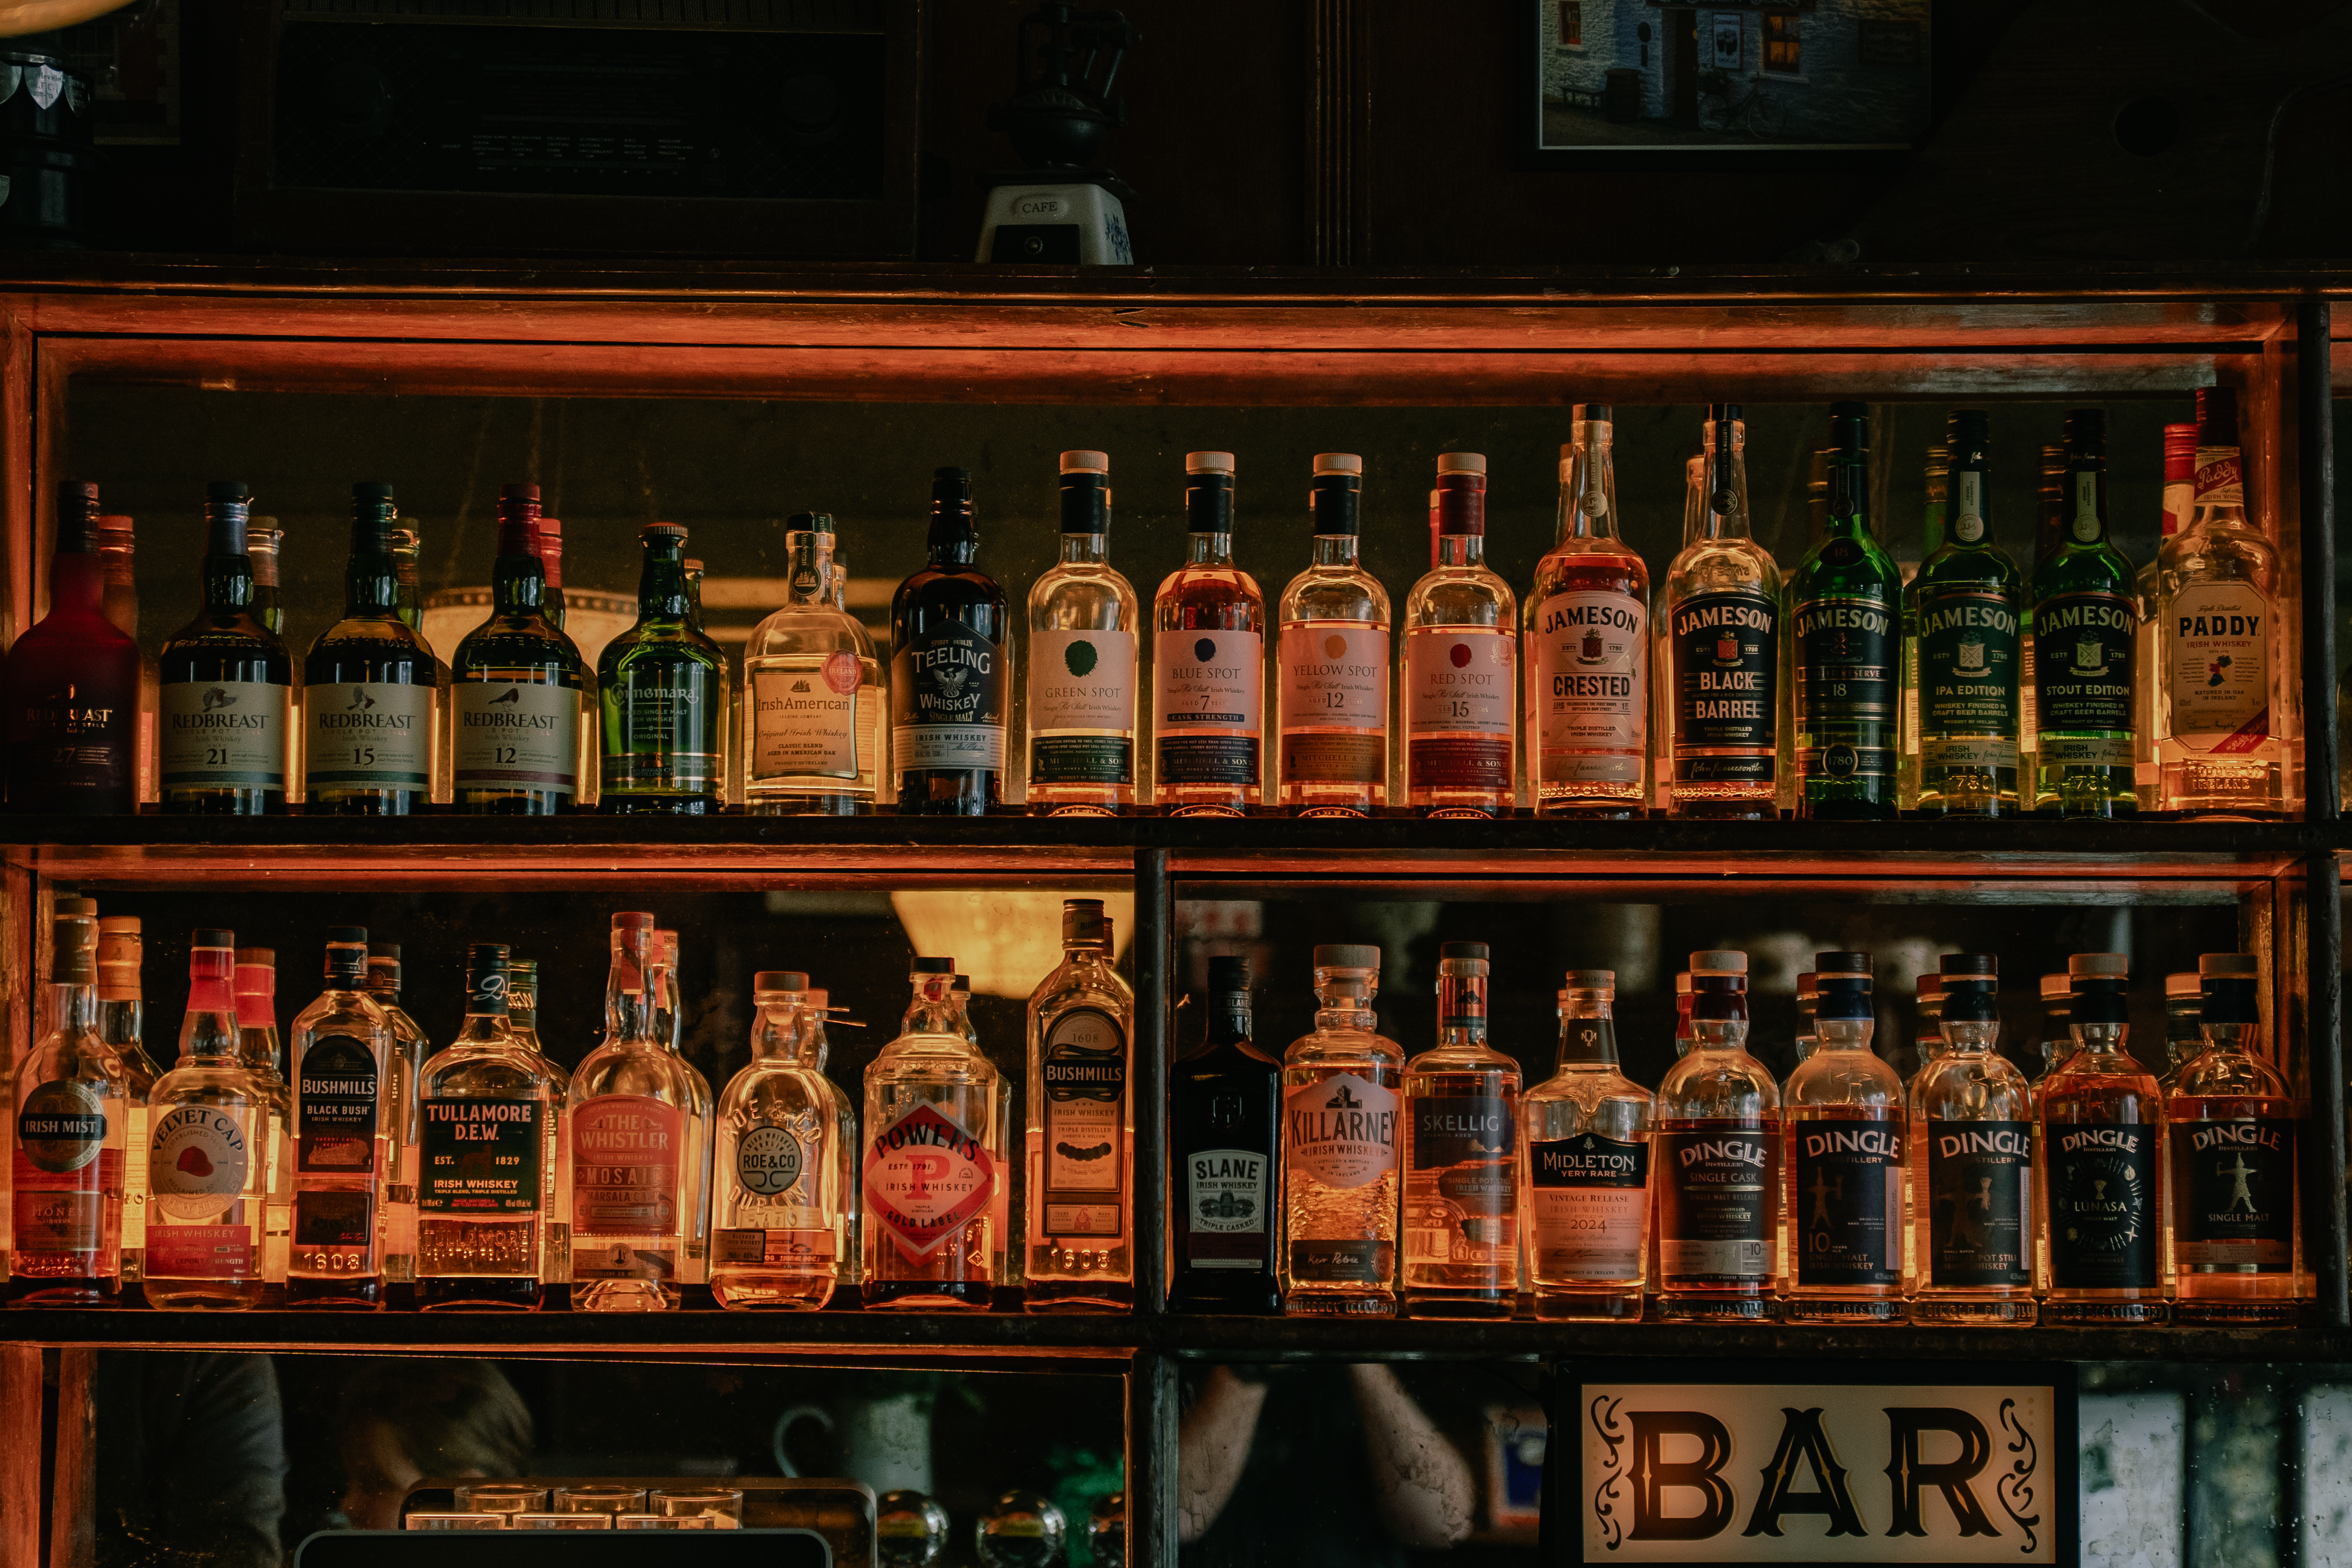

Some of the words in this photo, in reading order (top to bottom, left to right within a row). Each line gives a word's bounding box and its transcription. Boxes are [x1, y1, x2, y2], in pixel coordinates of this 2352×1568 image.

[2198, 461, 2239, 489] Paddy
[1546, 606, 1639, 635] JAMESON
[1679, 607, 1773, 636] JAMESON
[1798, 609, 1889, 638] JAMESON
[1922, 607, 2017, 637] JAMESON
[2040, 606, 2134, 637] JAMESON
[2179, 616, 2261, 637] PADDY
[911, 646, 990, 674] TEELING
[829, 668, 857, 676] IRELAND
[1173, 668, 1201, 679] BLUE
[1207, 668, 1240, 679] SPOT
[1293, 664, 1344, 678] YELLOW
[1348, 666, 1377, 678] SPOT
[1842, 669, 1880, 678] RESERVE
[1430, 674, 1455, 685] RED
[1460, 674, 1492, 685] SPOT
[1553, 676, 1630, 696] CRESTED
[1701, 672, 1755, 690] BLACK
[610, 683, 699, 706] Connemara
[1045, 687, 1087, 698] GREEN
[1091, 687, 1120, 698] SPOT
[1833, 684, 1847, 696] 18
[1936, 686, 1954, 696] IPA
[1958, 685, 2005, 696] EDITION
[2047, 686, 2081, 696] STOUT
[2086, 685, 2129, 697] EDITION
[758, 697, 849, 712] IrishAmerican
[920, 694, 980, 711] WHISKEY
[1200, 695, 1210, 711] 7
[1326, 692, 1344, 708] 12
[955, 712, 974, 722] MALT
[1452, 701, 1469, 717] 15
[1696, 701, 1760, 719] BARREL
[172, 714, 270, 730] REDBREAST
[319, 713, 415, 729] REDBREAST
[463, 711, 559, 730] REDBREAST
[52, 747, 76, 763] 27
[206, 748, 228, 765] 21
[353, 747, 375, 765] 15
[494, 747, 516, 764] 12
[1828, 756, 1853, 766] 1780
[2056, 752, 2098, 760] WHISKEY
[1072, 1033, 1099, 1044] 1608
[1046, 1065, 1123, 1082] BUSHMILLS
[303, 1080, 375, 1095] BUSHMILLS
[307, 1105, 338, 1115] BLACK
[342, 1106, 367, 1115] BUSH
[426, 1105, 531, 1123] TULLAMORE
[25, 1121, 58, 1133] IRISH
[63, 1120, 97, 1133] MIST
[606, 1114, 640, 1130] THE
[1292, 1110, 1398, 1149] KILLARNEY
[1423, 1115, 1499, 1132] SKELLIG
[153, 1109, 211, 1152] VELVET
[214, 1117, 244, 1154] CAP
[455, 1124, 499, 1141] D.E.W.
[2192, 1125, 2282, 1152] DINGLE
[580, 1132, 669, 1151] WHISTLER
[874, 1122, 980, 1162] POWERS
[1806, 1131, 1900, 1159] DINGLE
[1939, 1131, 2031, 1159] DINGLE
[2062, 1130, 2140, 1154] DINGLE
[1309, 1146, 1334, 1156] IRISH
[1680, 1141, 1768, 1169] DINGLE
[435, 1156, 454, 1165] EST.
[496, 1156, 520, 1165] 1829
[744, 1154, 795, 1169] ROE&CO
[1543, 1152, 1634, 1172] MIDLETON
[1195, 1159, 1259, 1180] SLANE
[1690, 1173, 1727, 1182] SINGLE
[1730, 1173, 1757, 1182] CASK
[434, 1180, 463, 1189] IRISH
[467, 1180, 518, 1189] WHISKEY
[886, 1183, 915, 1191] IRISH
[921, 1183, 974, 1192] WHISKEY
[1549, 1194, 1587, 1203] VINTAGE
[1590, 1194, 1630, 1203] RELEASE
[32, 1205, 85, 1217] HONEY
[2208, 1213, 2241, 1223] SINGLE
[2245, 1213, 2269, 1222] MALT
[155, 1229, 179, 1238] IRISH
[184, 1229, 235, 1238] WHISKEY
[1570, 1219, 1607, 1234] 2024
[1750, 1244, 1761, 1256] 10
[1809, 1233, 1831, 1253] 10
[304, 1253, 360, 1272] 1608
[1624, 1406, 2003, 1542] BAR
